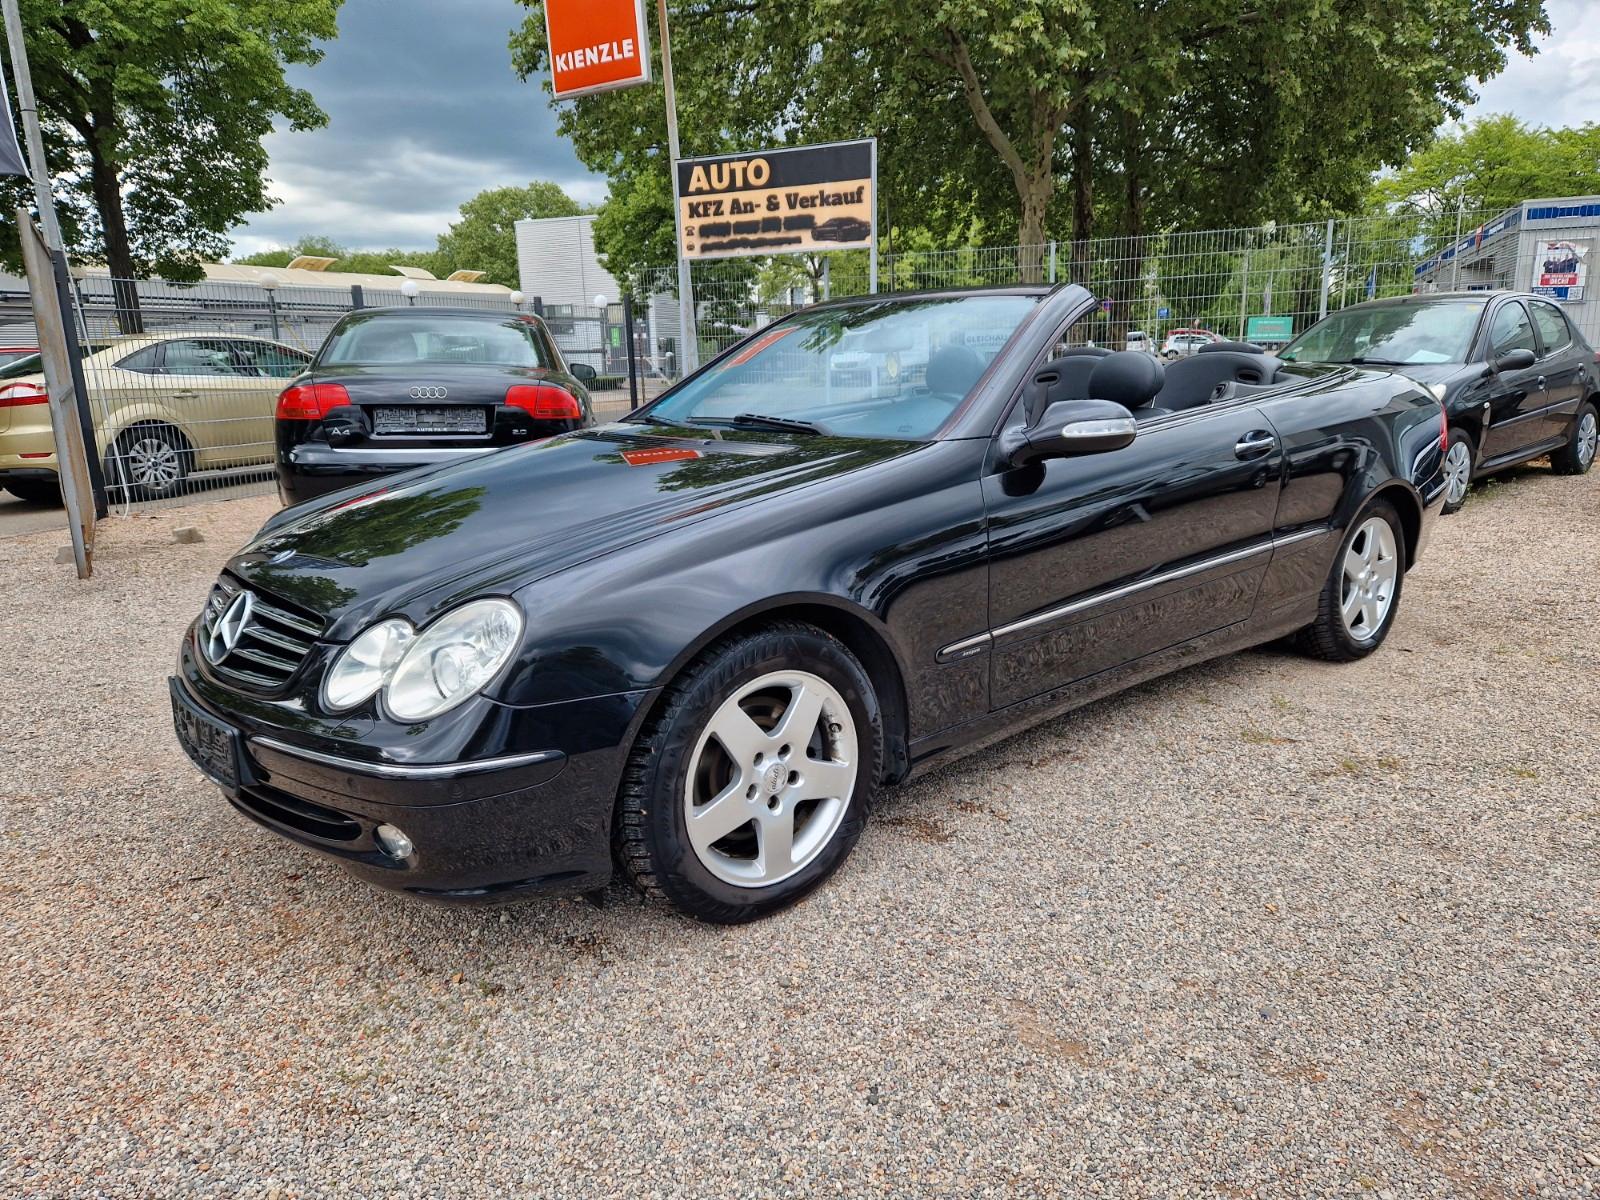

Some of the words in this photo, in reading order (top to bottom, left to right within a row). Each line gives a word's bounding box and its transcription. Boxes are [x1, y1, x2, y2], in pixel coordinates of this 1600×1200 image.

[555, 38, 634, 73] KIENZLE
[688, 158, 771, 192] AUTO
[688, 200, 724, 218] KFZ
[730, 198, 761, 215] An-
[766, 194, 780, 212] &
[785, 186, 865, 210] Verkauf
